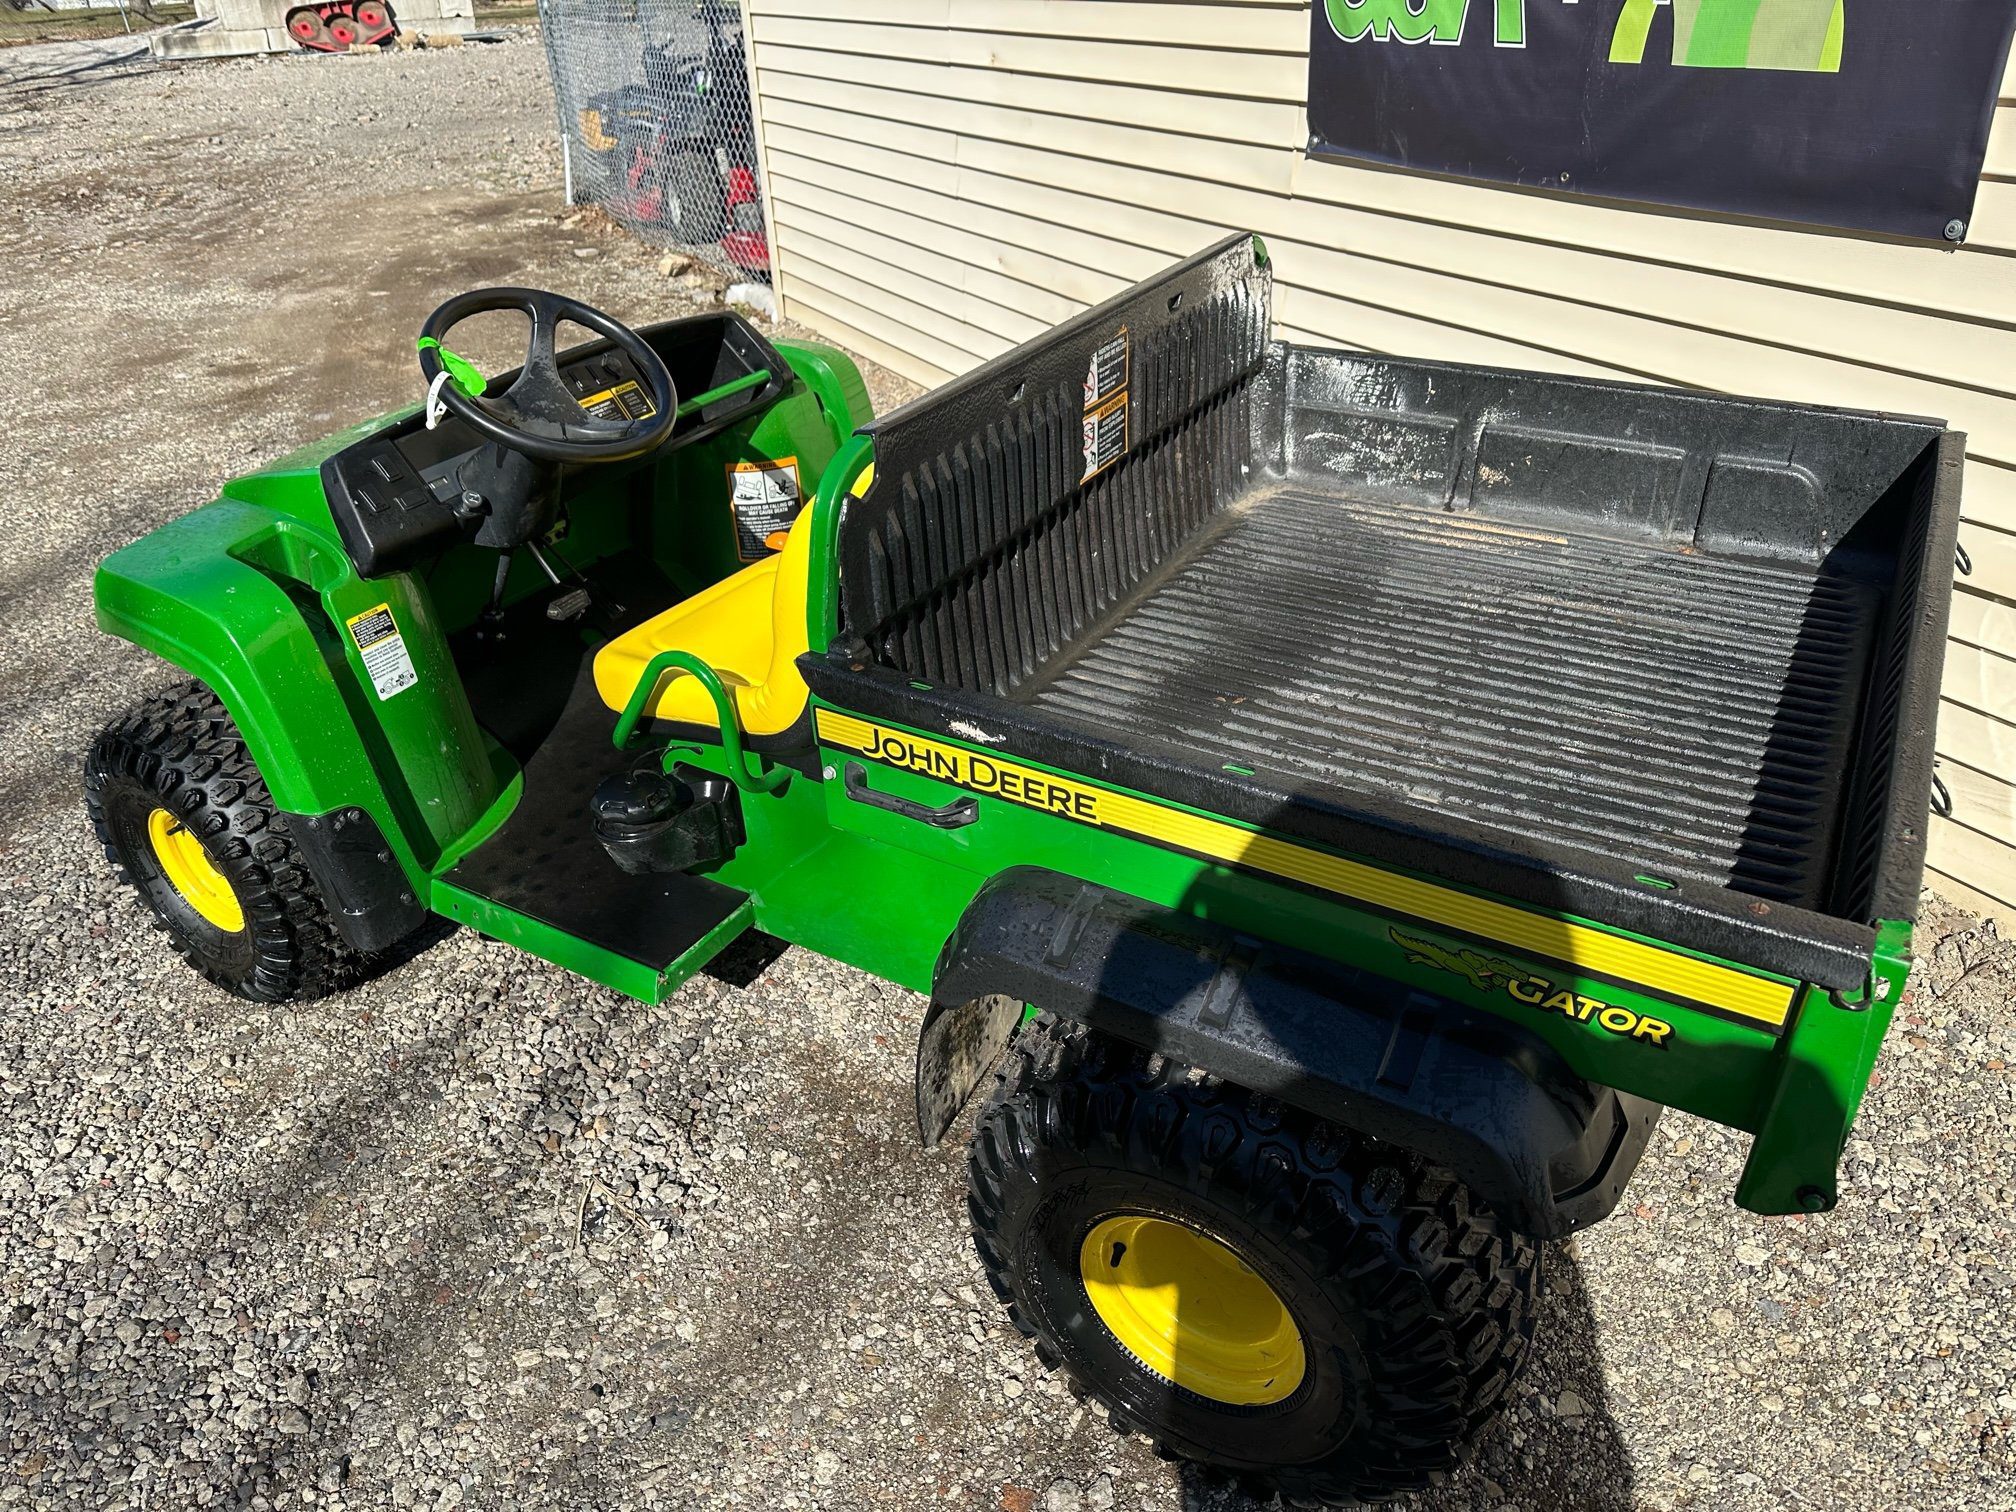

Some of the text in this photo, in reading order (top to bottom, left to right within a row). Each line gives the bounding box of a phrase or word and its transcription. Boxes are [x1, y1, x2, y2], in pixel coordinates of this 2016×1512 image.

[1104, 395, 1125, 415] WARNING
[747, 463, 777, 471] WARNING
[862, 728, 1098, 821] JOHN DEERE
[1506, 975, 1674, 1047] GATOR
